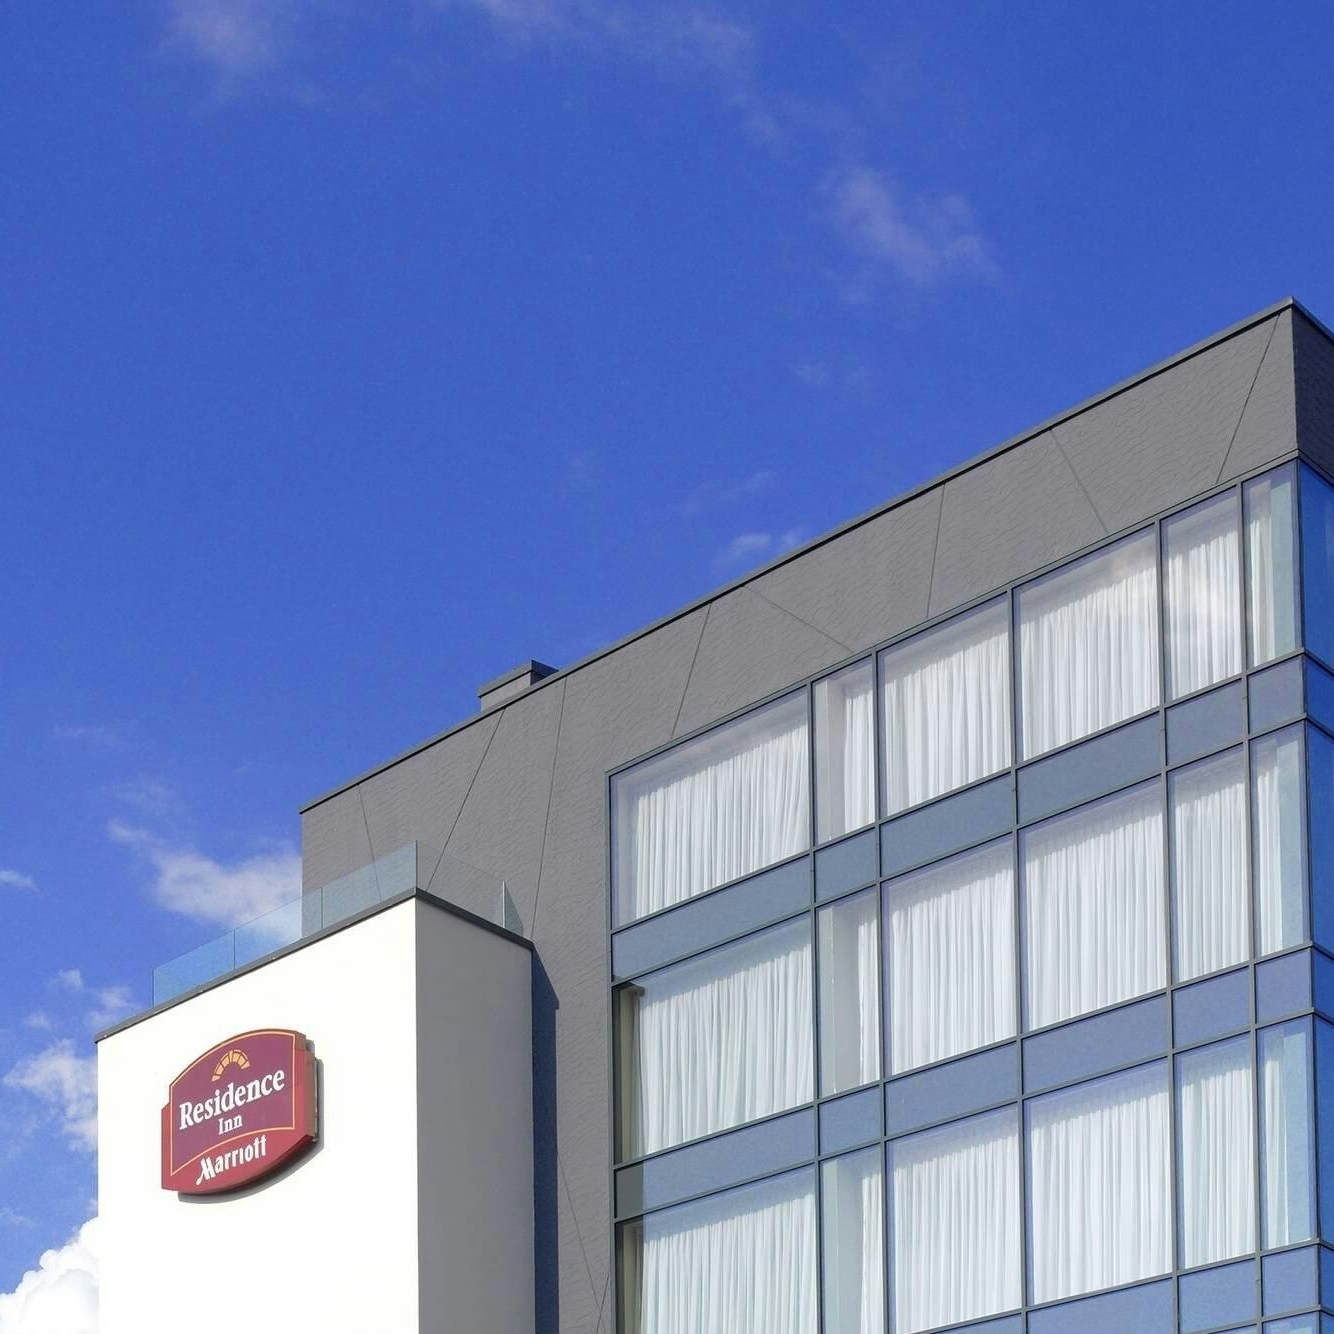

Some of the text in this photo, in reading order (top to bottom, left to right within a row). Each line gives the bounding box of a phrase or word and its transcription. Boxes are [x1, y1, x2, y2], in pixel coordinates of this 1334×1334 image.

[179, 1069, 285, 1130] Residence
[218, 1114, 243, 1135] Inn
[196, 1134, 267, 1185] Marriott
